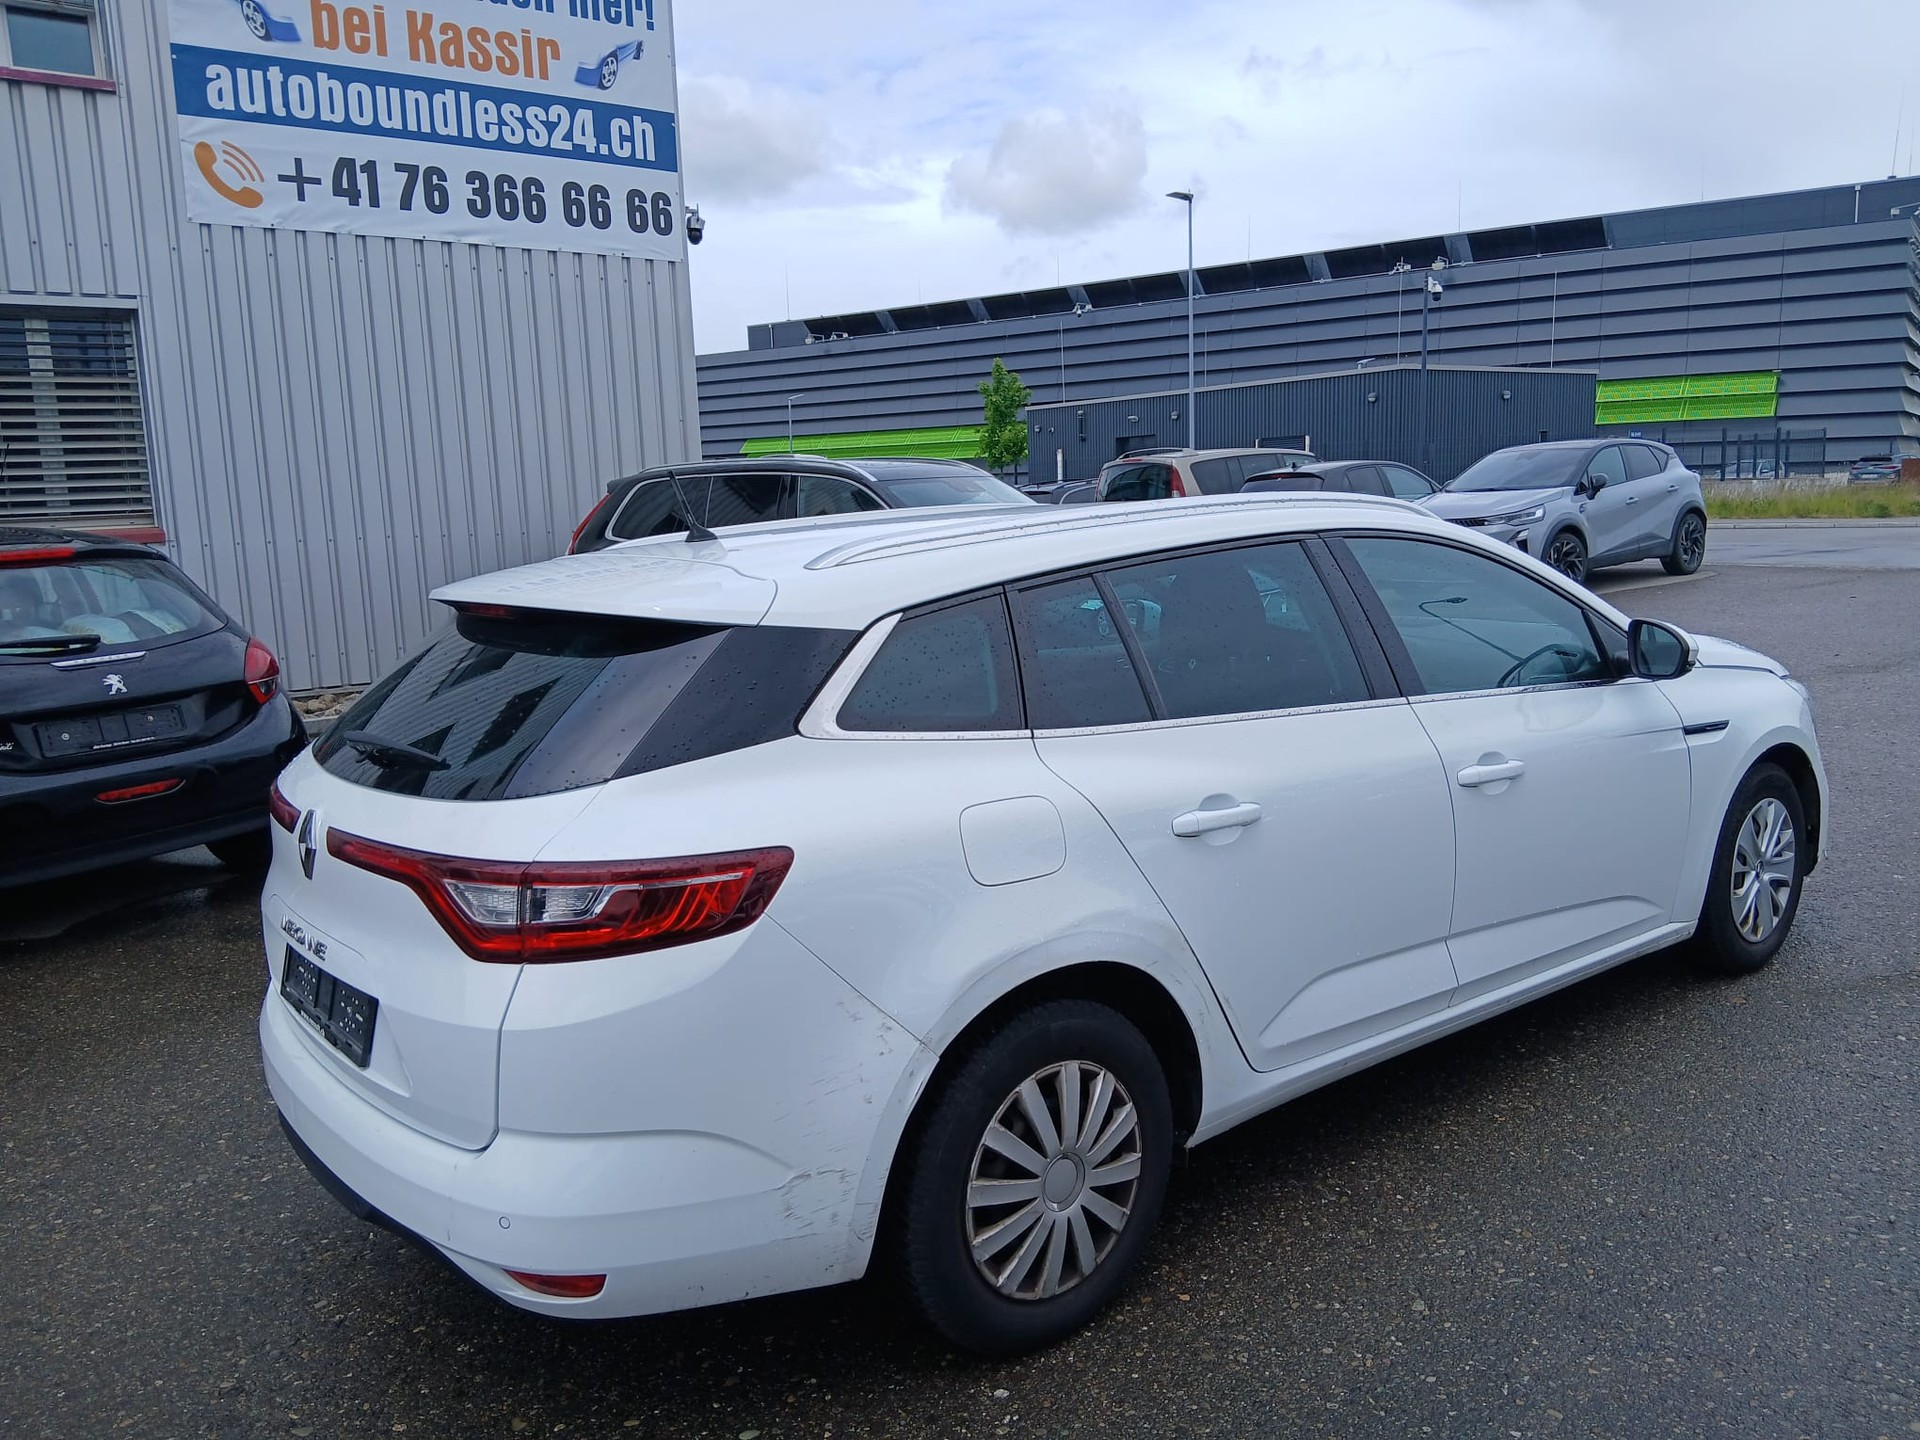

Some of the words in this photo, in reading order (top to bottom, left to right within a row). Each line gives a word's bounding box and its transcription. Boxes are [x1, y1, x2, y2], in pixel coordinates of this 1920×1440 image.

[309, 0, 388, 57] bei
[405, 9, 561, 81] Kassir
[205, 63, 656, 162] autoboundless24.ch
[393, 162, 450, 215] 76
[465, 170, 547, 224] 366
[561, 181, 613, 231] 66
[626, 188, 674, 237] 66
